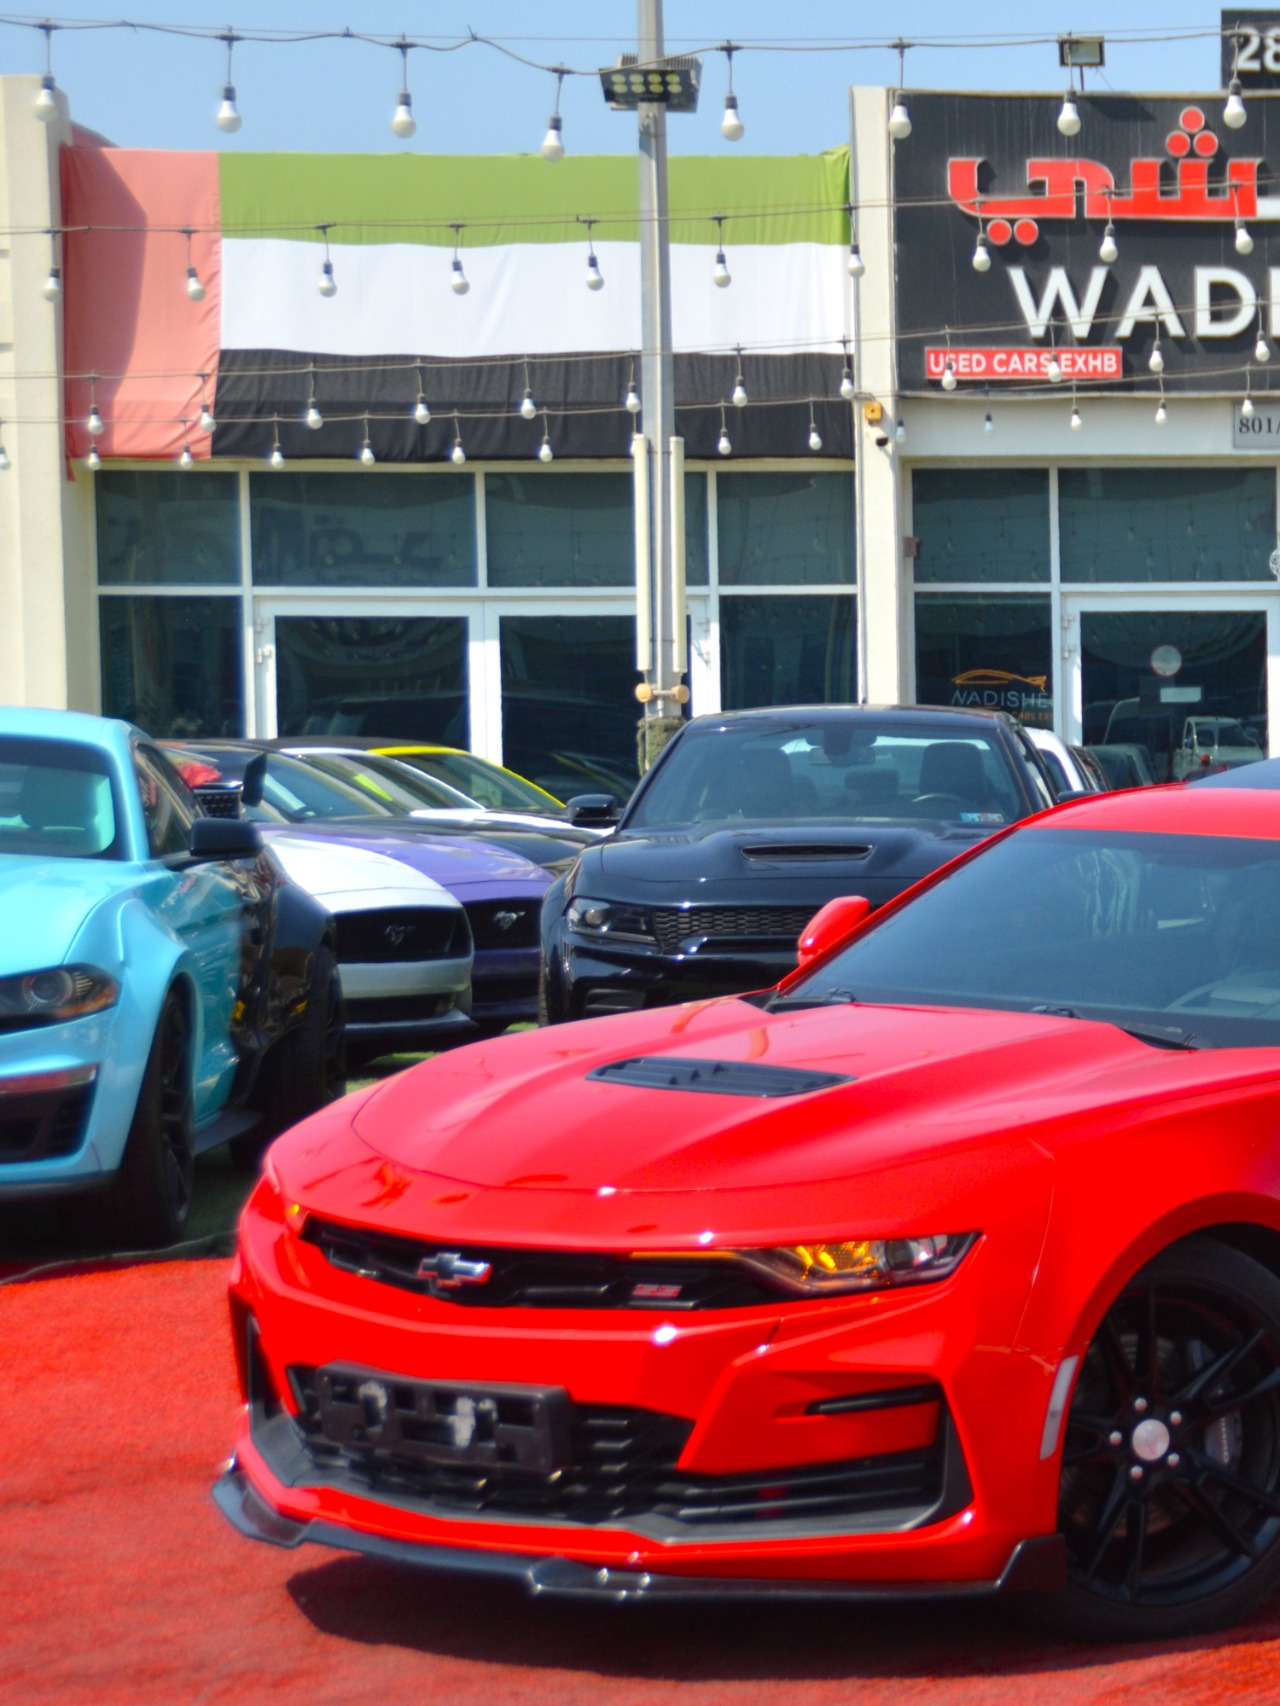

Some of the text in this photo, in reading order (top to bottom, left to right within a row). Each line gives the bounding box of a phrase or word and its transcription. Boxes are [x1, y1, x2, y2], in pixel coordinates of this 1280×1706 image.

[929, 353, 1118, 373] USED CARS EXHB
